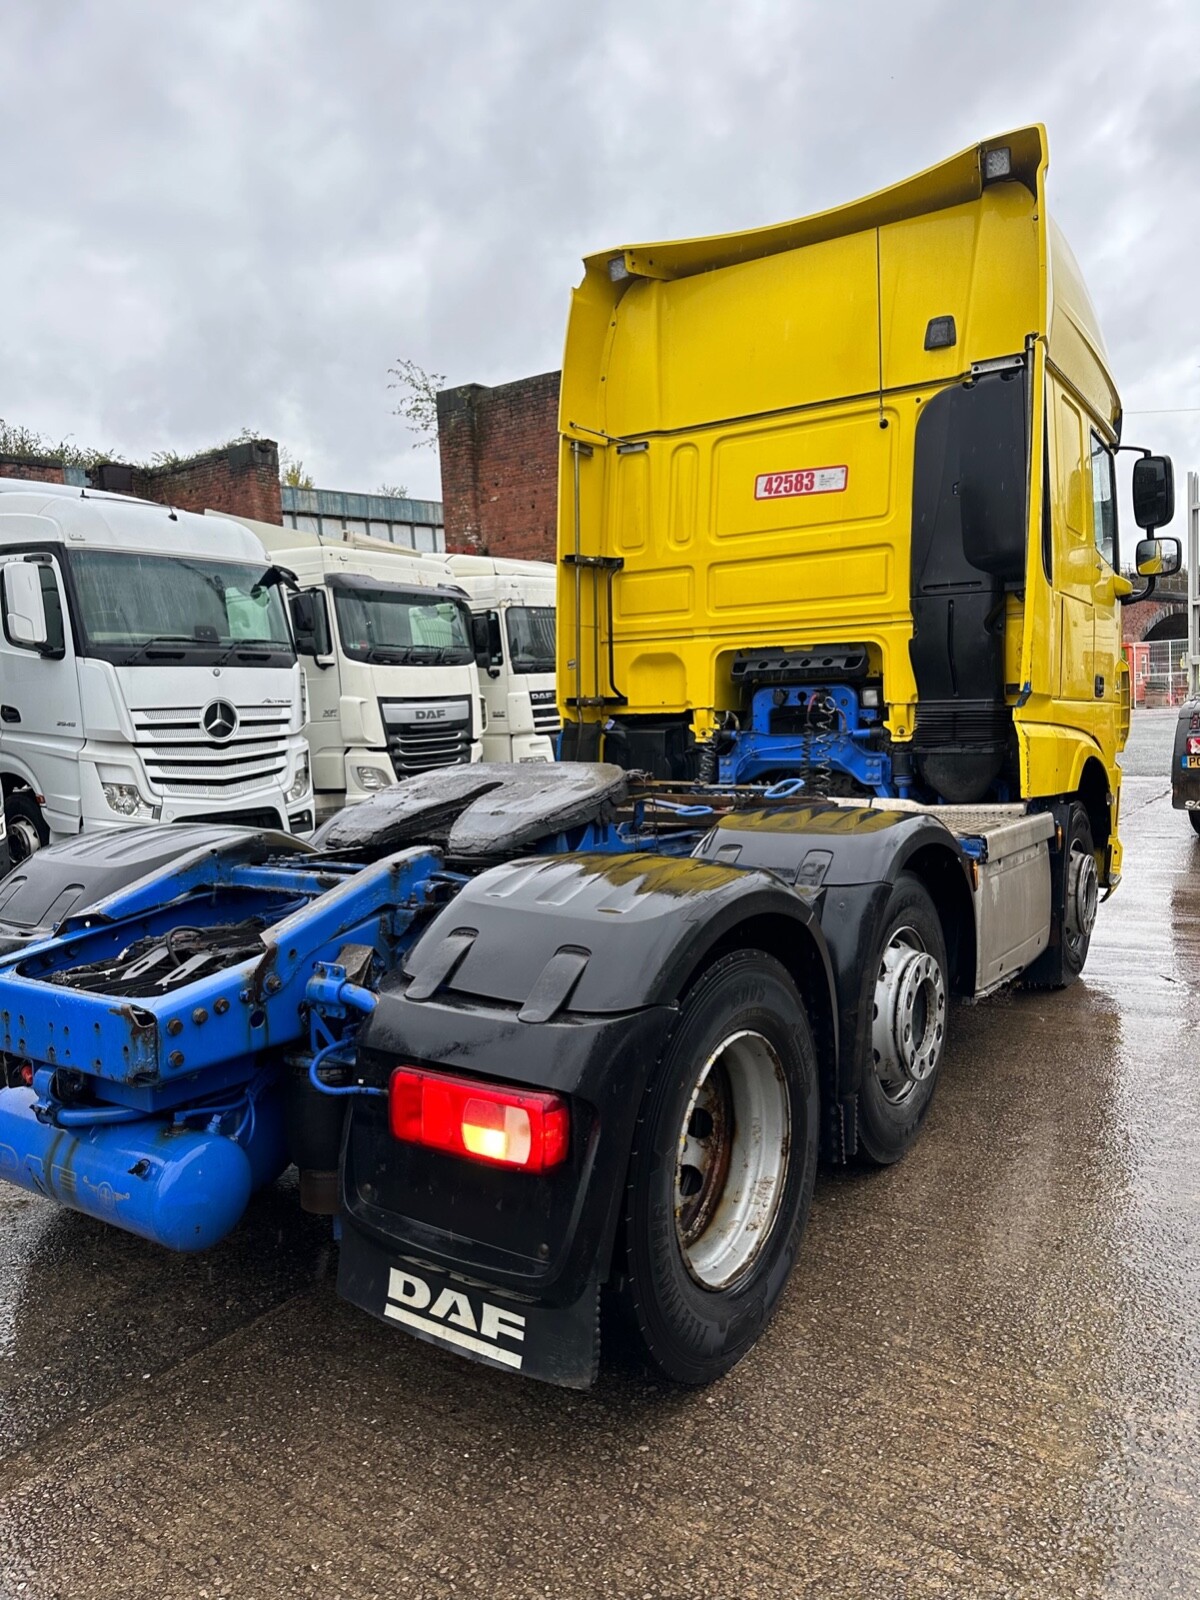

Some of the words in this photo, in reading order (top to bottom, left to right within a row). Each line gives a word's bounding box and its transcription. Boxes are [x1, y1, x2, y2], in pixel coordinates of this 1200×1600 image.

[764, 472, 815, 495] 42583
[531, 692, 553, 700] DAF
[415, 709, 446, 720] DAF
[387, 1266, 526, 1341] DAF
